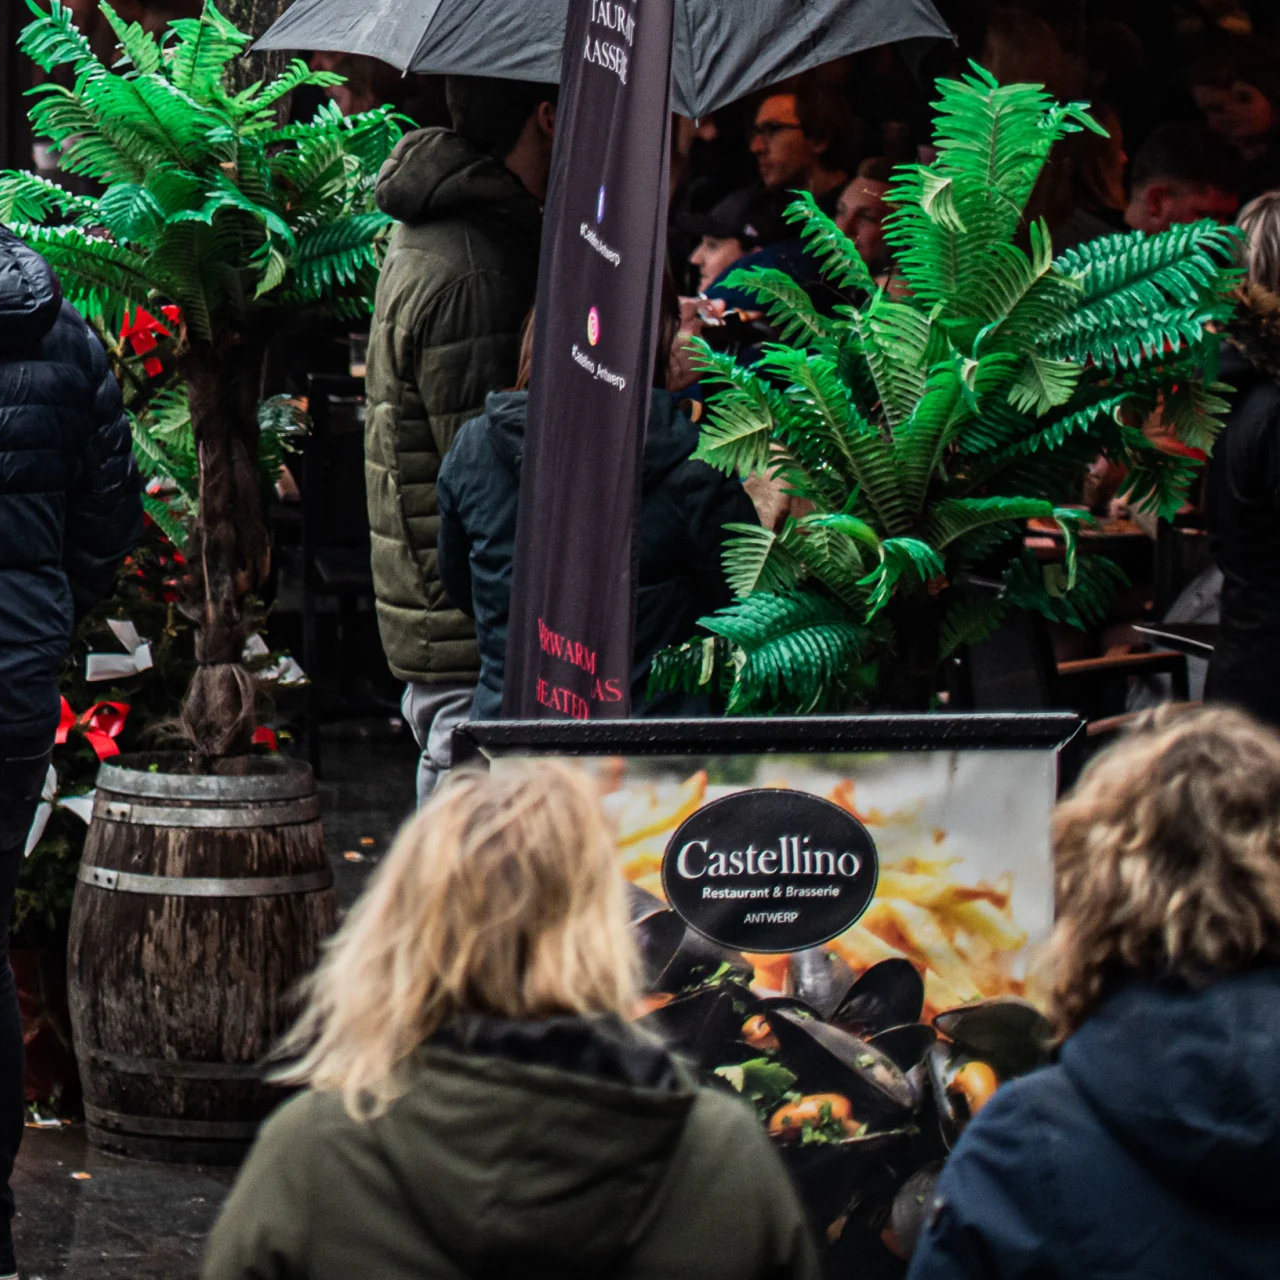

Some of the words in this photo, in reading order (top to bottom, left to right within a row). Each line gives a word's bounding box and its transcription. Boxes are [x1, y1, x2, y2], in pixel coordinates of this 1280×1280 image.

[677, 835, 861, 880] Castellino
[702, 886, 770, 899] Restaurant
[773, 886, 782, 898] &
[786, 884, 840, 898] Brasserie
[743, 911, 799, 924] ANTWERP
